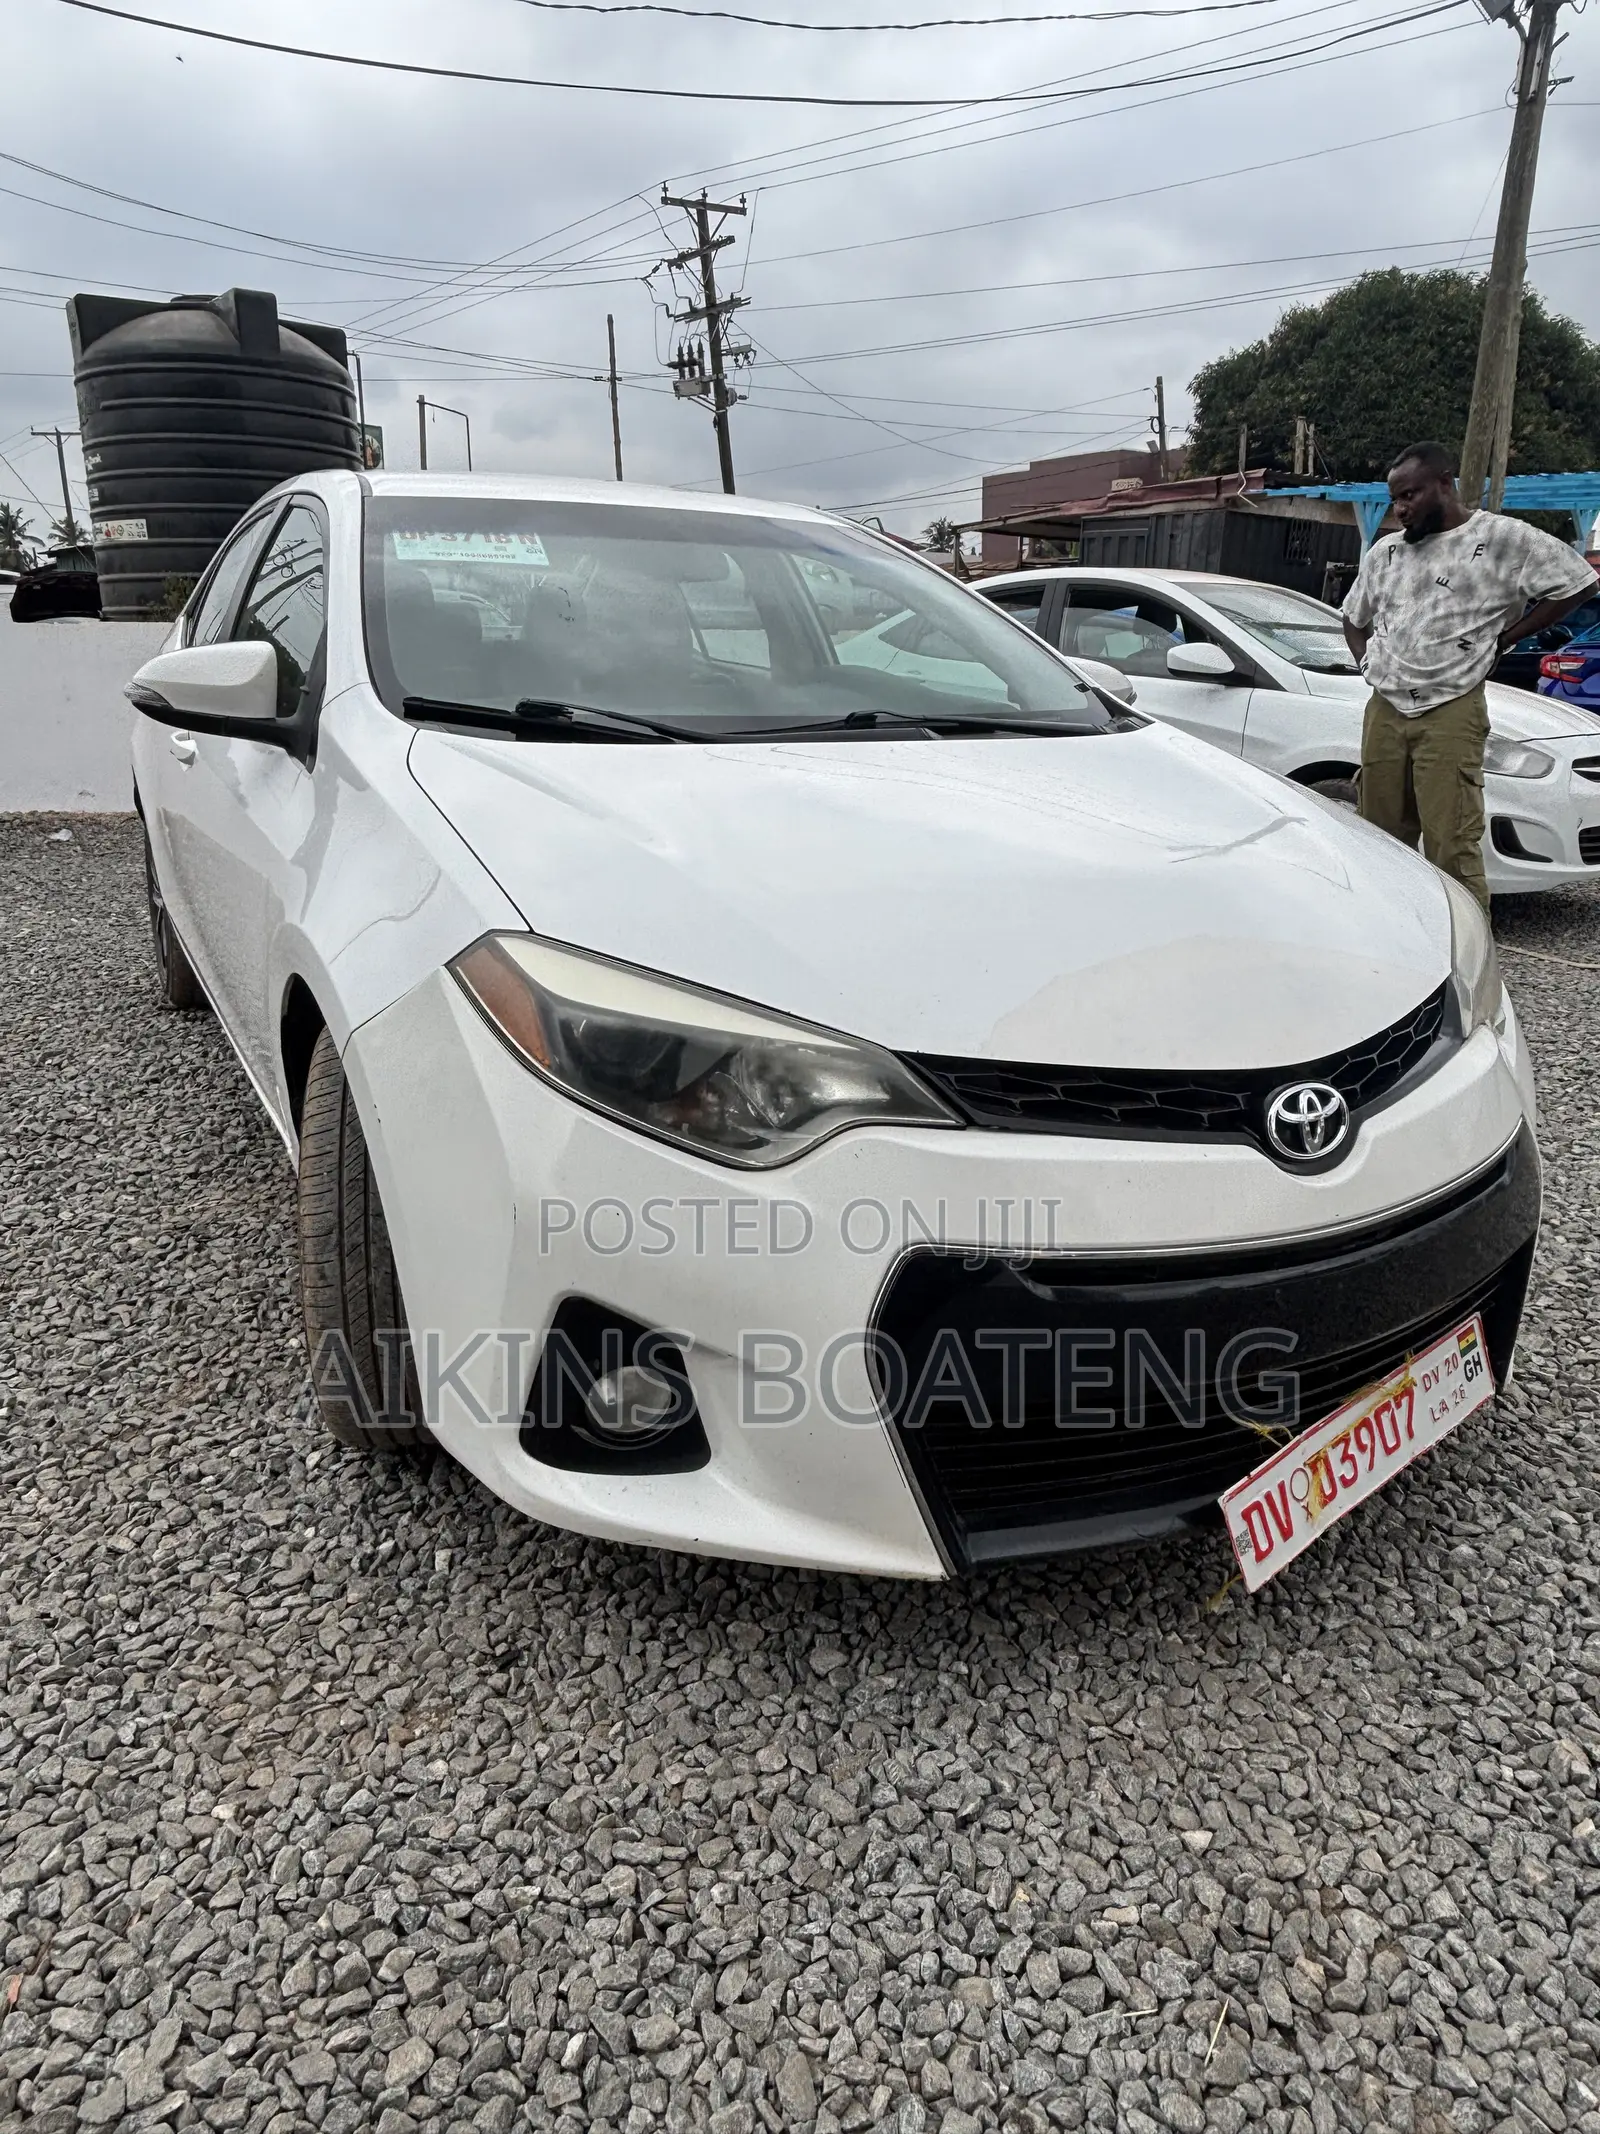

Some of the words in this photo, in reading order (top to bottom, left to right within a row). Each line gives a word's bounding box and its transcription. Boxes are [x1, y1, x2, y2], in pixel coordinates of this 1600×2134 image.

[1422, 1366, 1440, 1393] DV
[1444, 1352, 1460, 1377] 20
[1464, 1351, 1484, 1383] GH
[1241, 1480, 1295, 1564] DV
[1307, 1386, 1416, 1510] 03907
